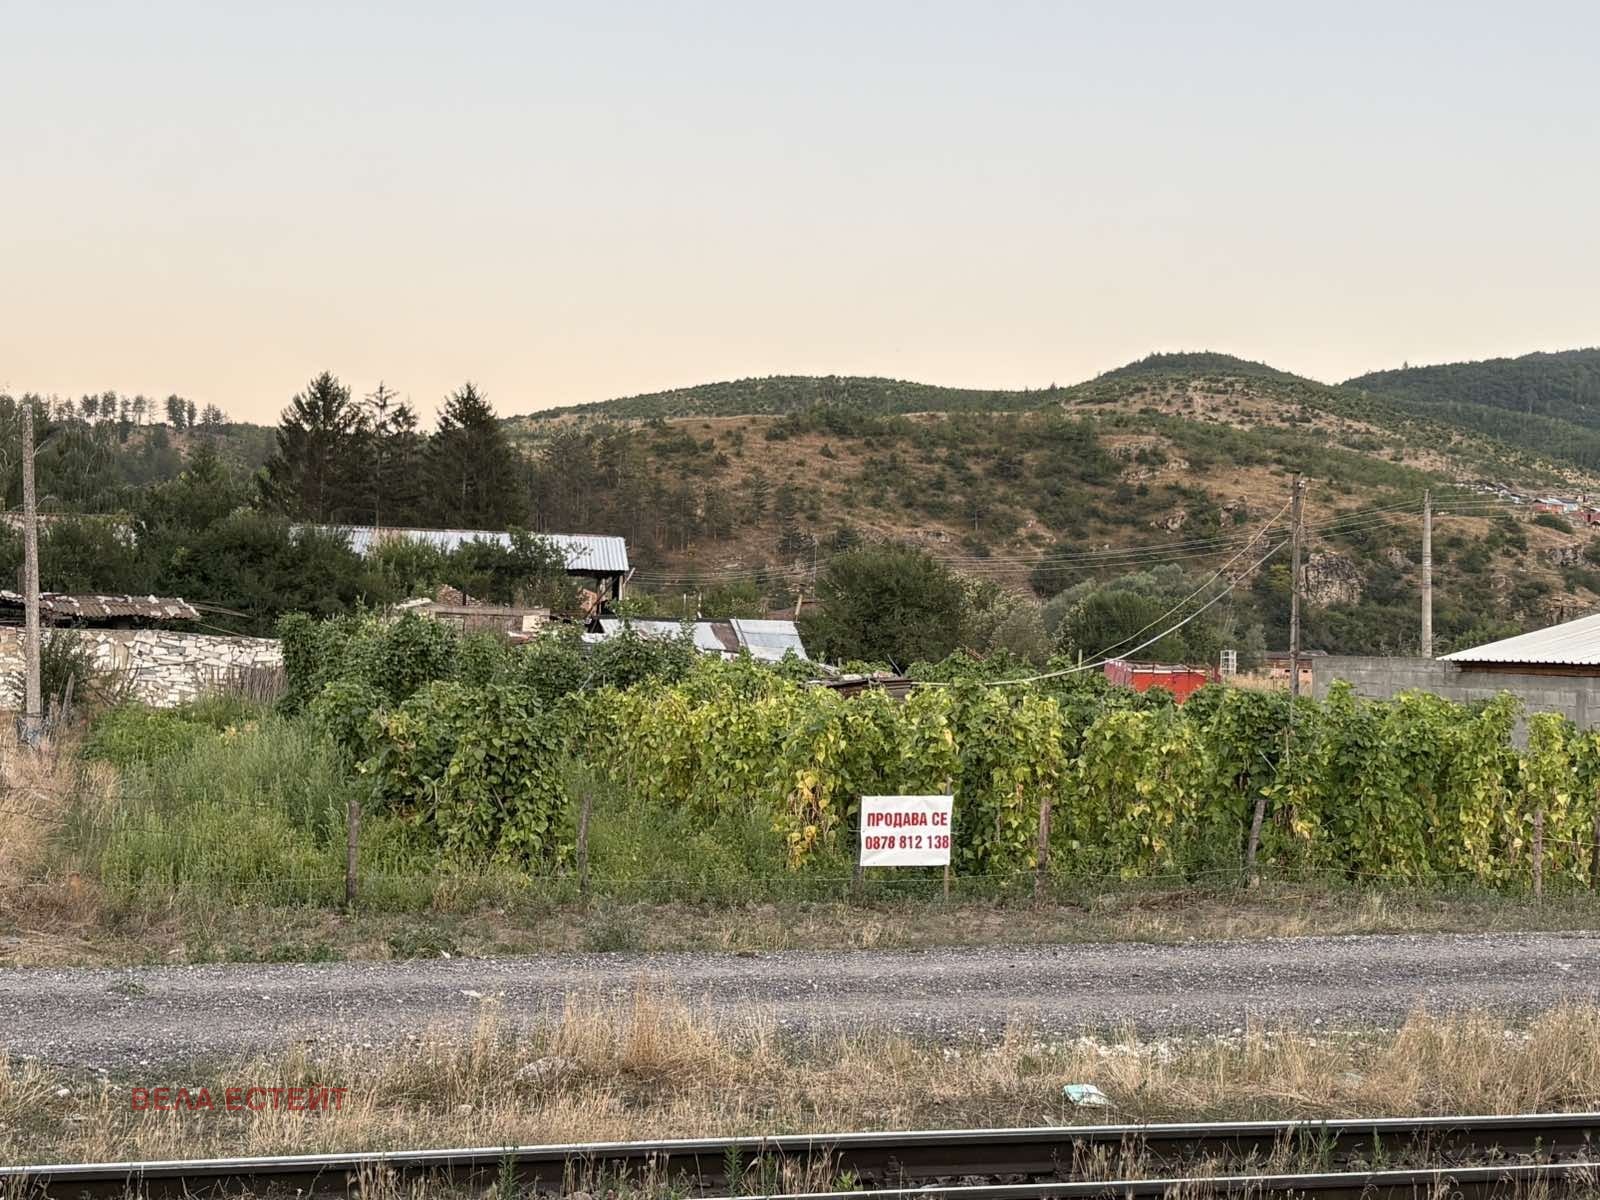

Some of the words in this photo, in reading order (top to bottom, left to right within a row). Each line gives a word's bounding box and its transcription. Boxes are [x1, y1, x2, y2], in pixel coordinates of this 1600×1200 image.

[867, 812, 928, 828] ПРОДАВА
[932, 812, 948, 826] СЕ
[865, 836, 895, 850] 0878
[899, 835, 922, 849] 812
[927, 835, 949, 849] 138
